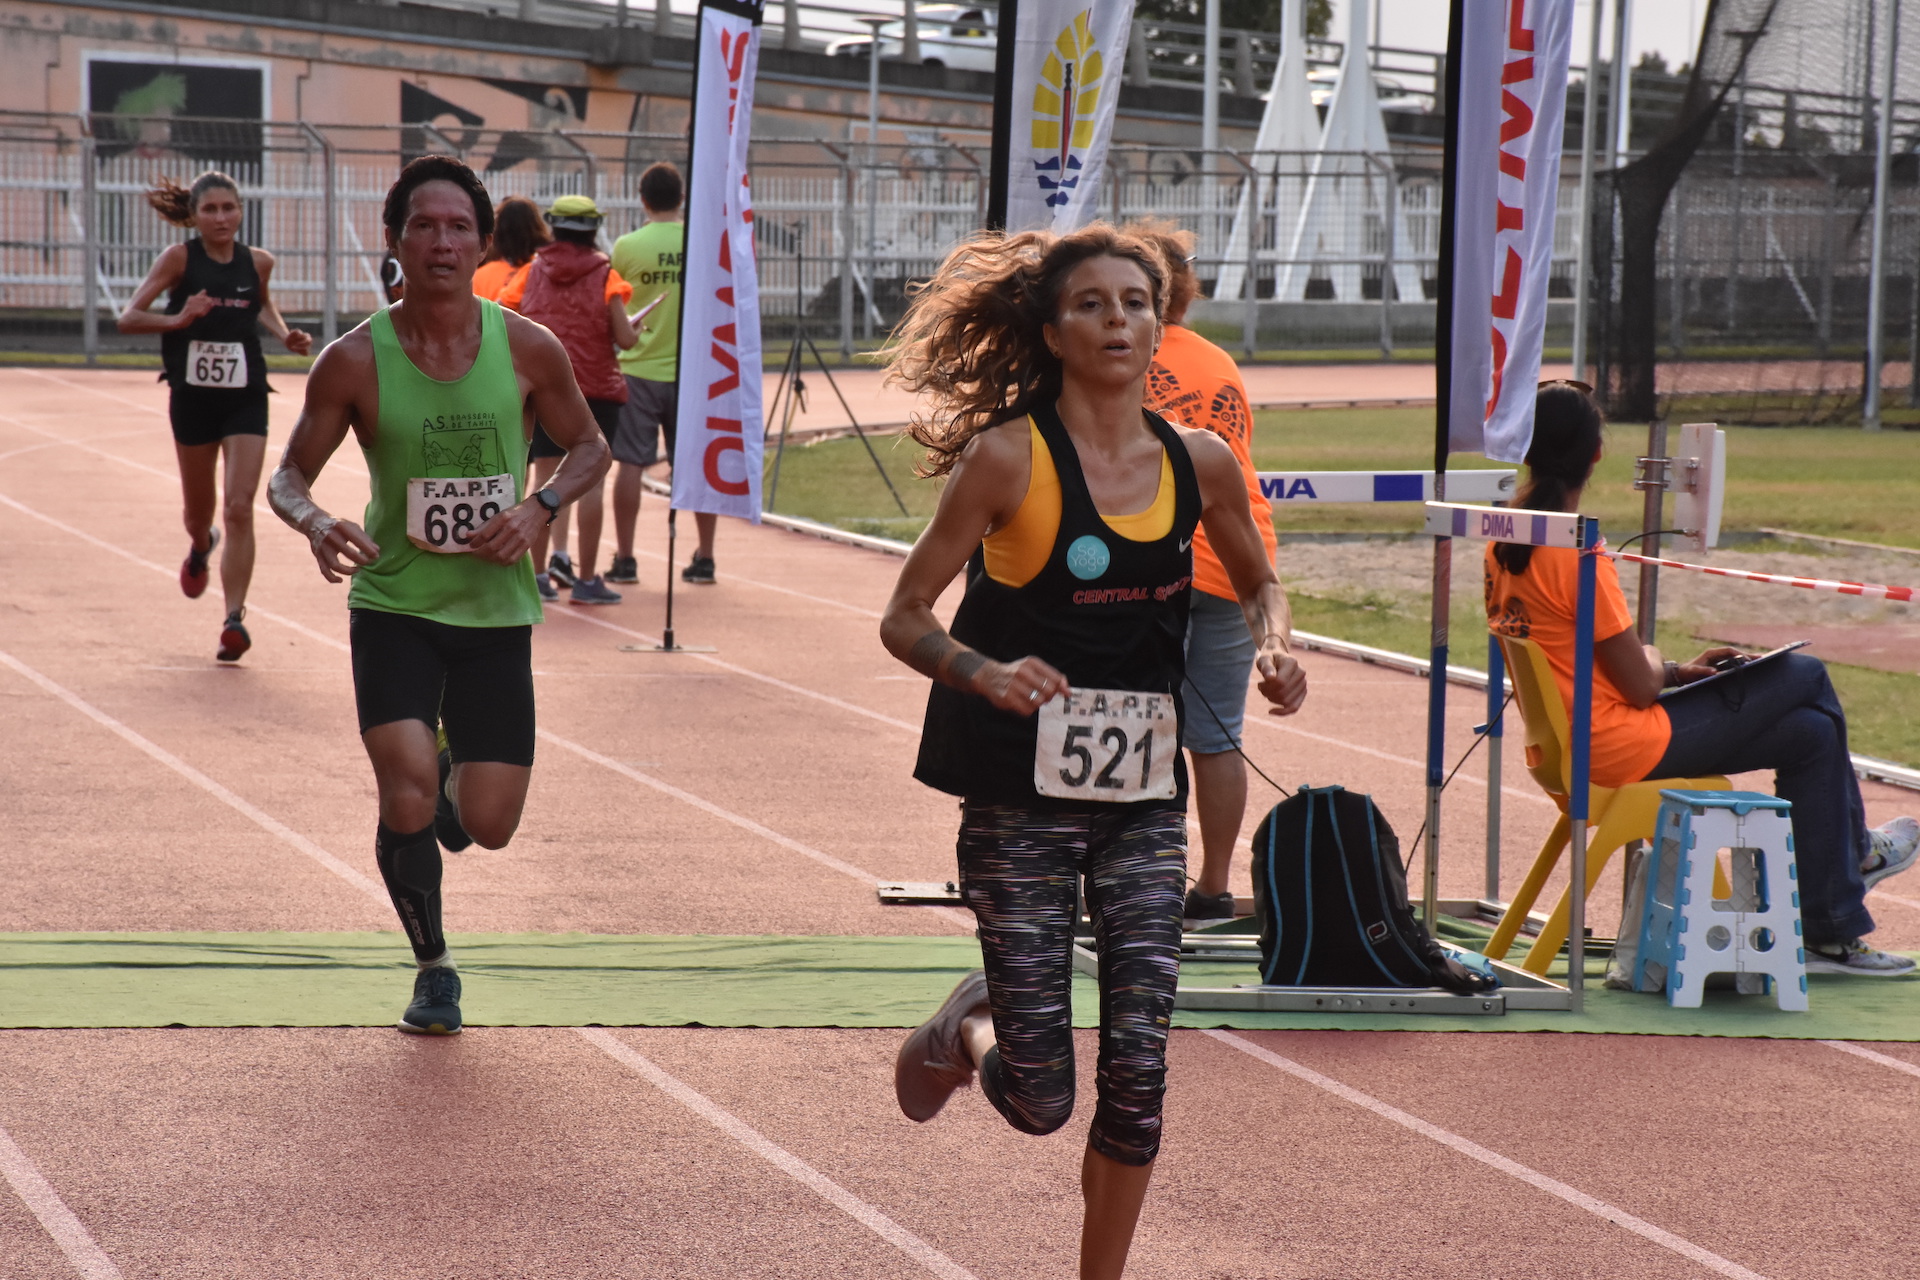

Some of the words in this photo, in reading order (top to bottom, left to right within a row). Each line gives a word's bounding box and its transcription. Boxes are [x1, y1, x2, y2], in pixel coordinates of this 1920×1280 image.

[195, 356, 239, 383] 657
[422, 415, 449, 432] A.S.
[450, 412, 496, 422] BRASSERIE
[452, 421, 462, 429] DE
[467, 420, 497, 428] TAHITI
[423, 479, 503, 498] F.A.P.F.
[1259, 478, 1318, 499] MA
[1481, 513, 1515, 539] DIMA
[1071, 556, 1106, 572] Yoga
[1072, 587, 1149, 605] CENTRAL
[1063, 690, 1164, 719] F.A.P.F.
[1058, 724, 1154, 790] 521
